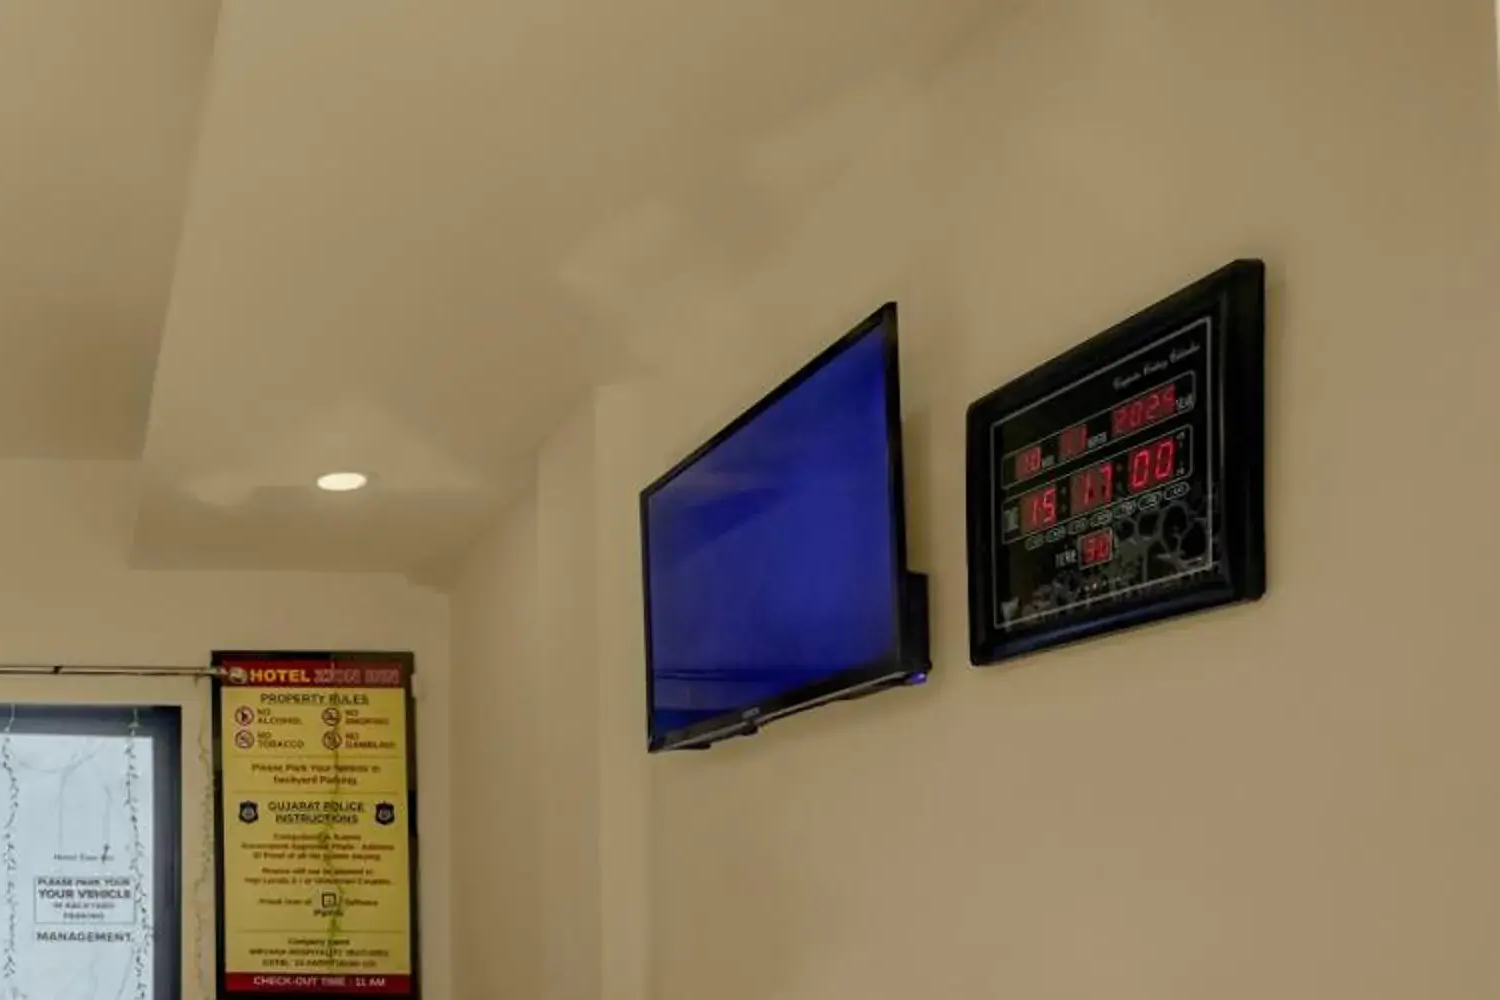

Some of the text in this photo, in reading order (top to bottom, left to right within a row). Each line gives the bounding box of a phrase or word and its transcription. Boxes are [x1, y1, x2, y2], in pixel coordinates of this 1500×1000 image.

[1130, 438, 1175, 489] 00
[250, 669, 310, 683] HOTEL
[260, 693, 369, 706] PROPERTY RULES
[268, 801, 364, 812] GUJARAT POLICE
[275, 814, 358, 824] INSTRUCTIONS
[38, 889, 131, 899] YOUR VEHICLE
[369, 977, 386, 987] AM
